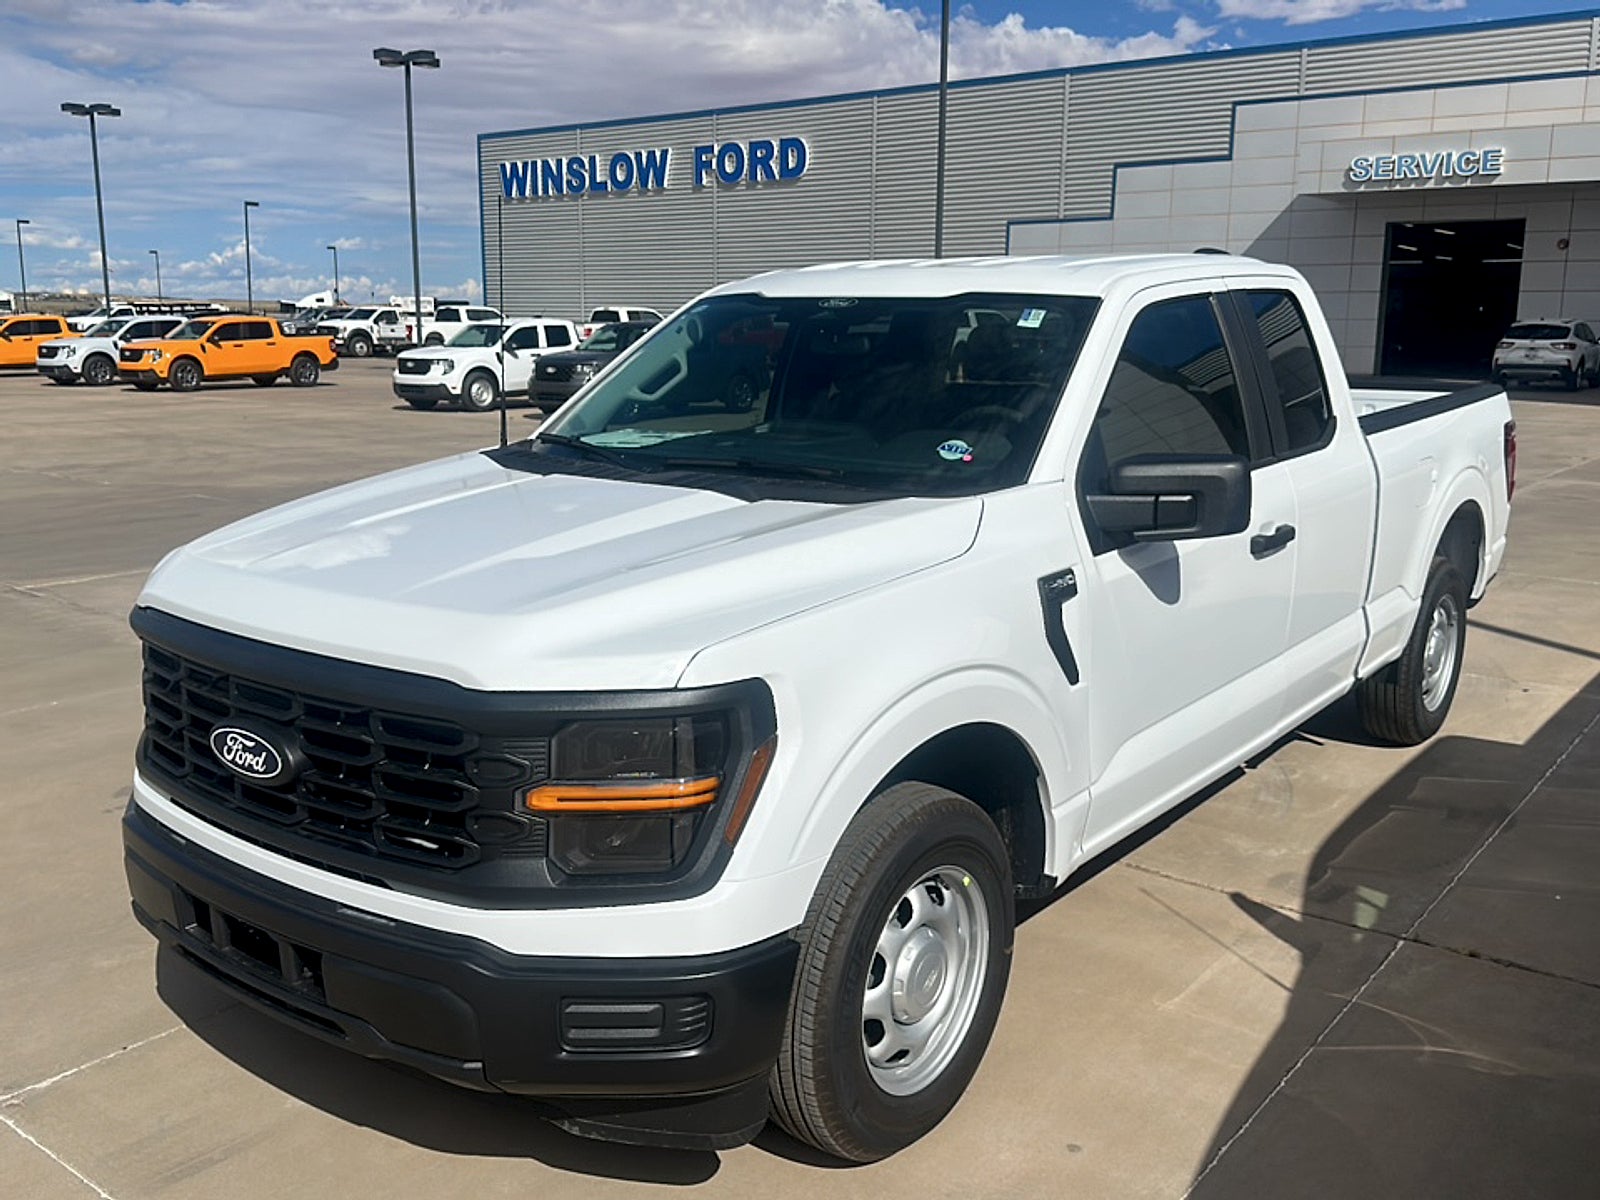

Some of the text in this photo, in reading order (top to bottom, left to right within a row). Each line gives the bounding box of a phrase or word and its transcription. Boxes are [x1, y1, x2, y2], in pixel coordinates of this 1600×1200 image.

[500, 137, 808, 198] WINSLOW FORD
[1350, 149, 1504, 181] SERVICE
[223, 733, 267, 772] Ford
